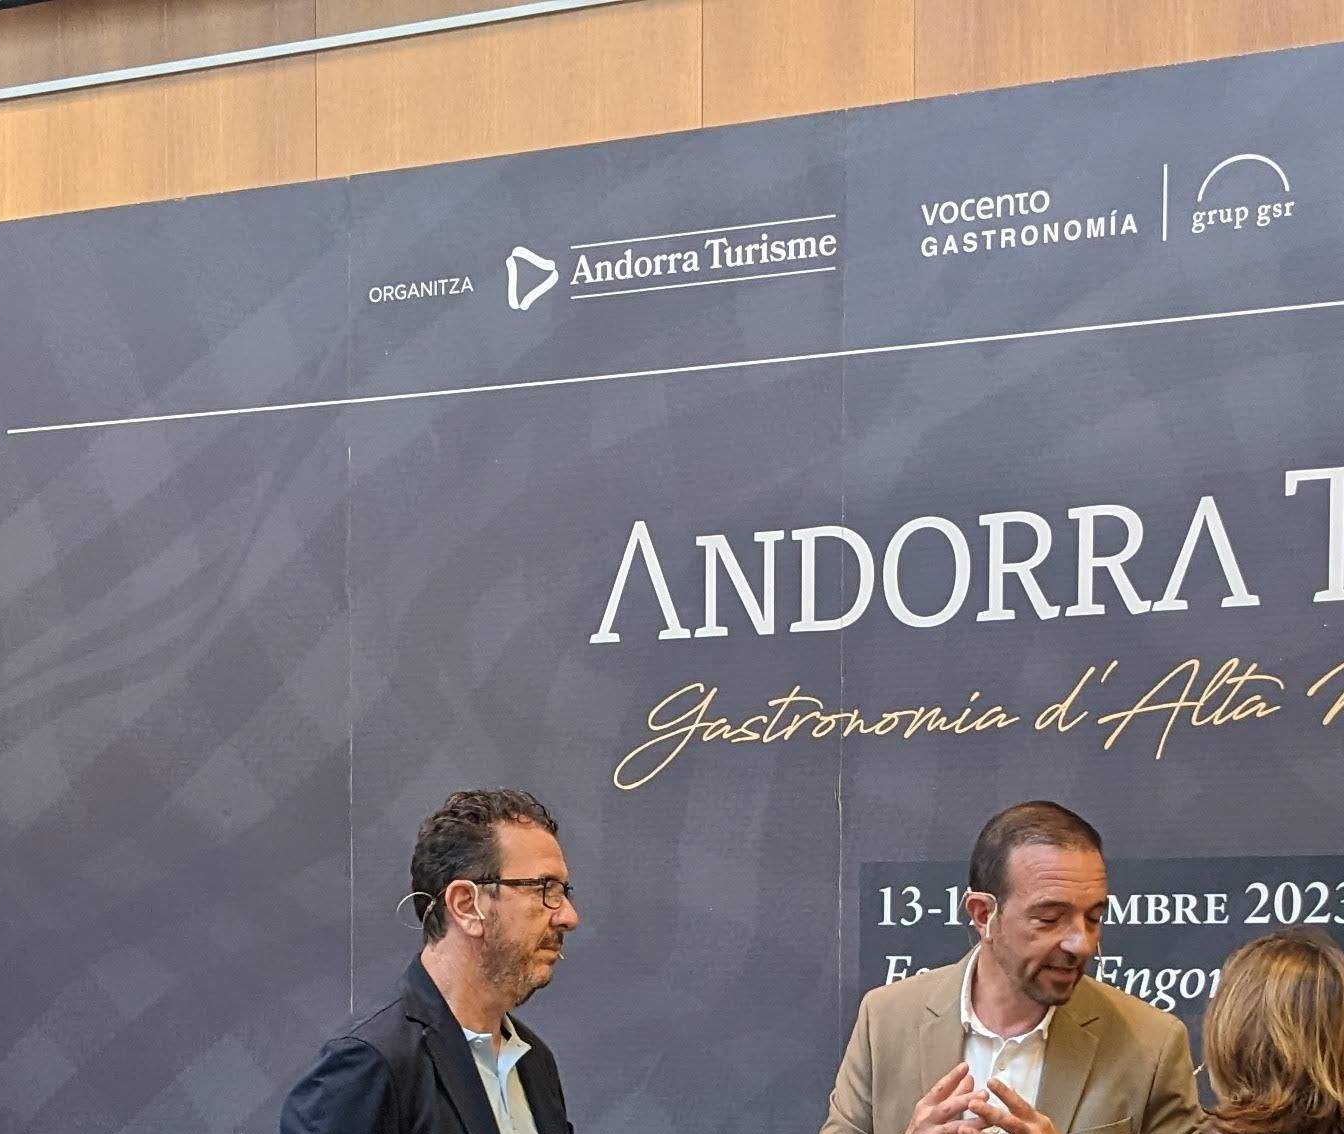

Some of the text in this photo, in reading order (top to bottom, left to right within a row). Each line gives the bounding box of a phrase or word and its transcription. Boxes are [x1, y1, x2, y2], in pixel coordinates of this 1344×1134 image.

[920, 210, 1138, 258] GASTRONOMÍA
[1191, 198, 1296, 234] grup gsr
[570, 232, 838, 286] Andorra Turisme
[368, 275, 475, 303] ORGANITZA
[589, 495, 1262, 644] ANDORRA
[613, 682, 1021, 790] Gastronomia
[877, 885, 976, 926] 13-1
